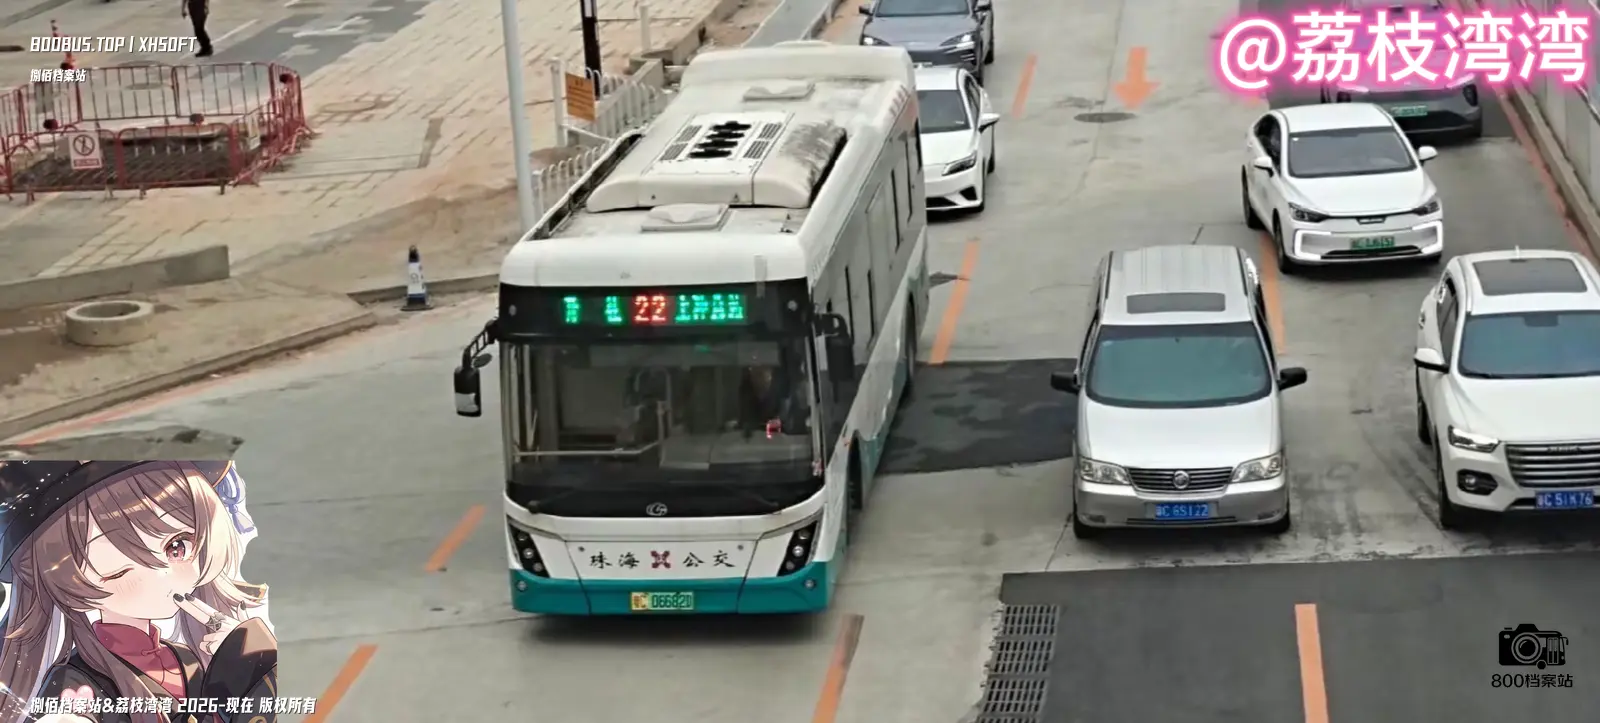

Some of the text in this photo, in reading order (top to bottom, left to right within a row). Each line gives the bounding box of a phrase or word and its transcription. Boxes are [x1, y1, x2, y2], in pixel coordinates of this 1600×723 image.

[634, 295, 667, 321] 22
[590, 550, 735, 569] 珠海 公交
